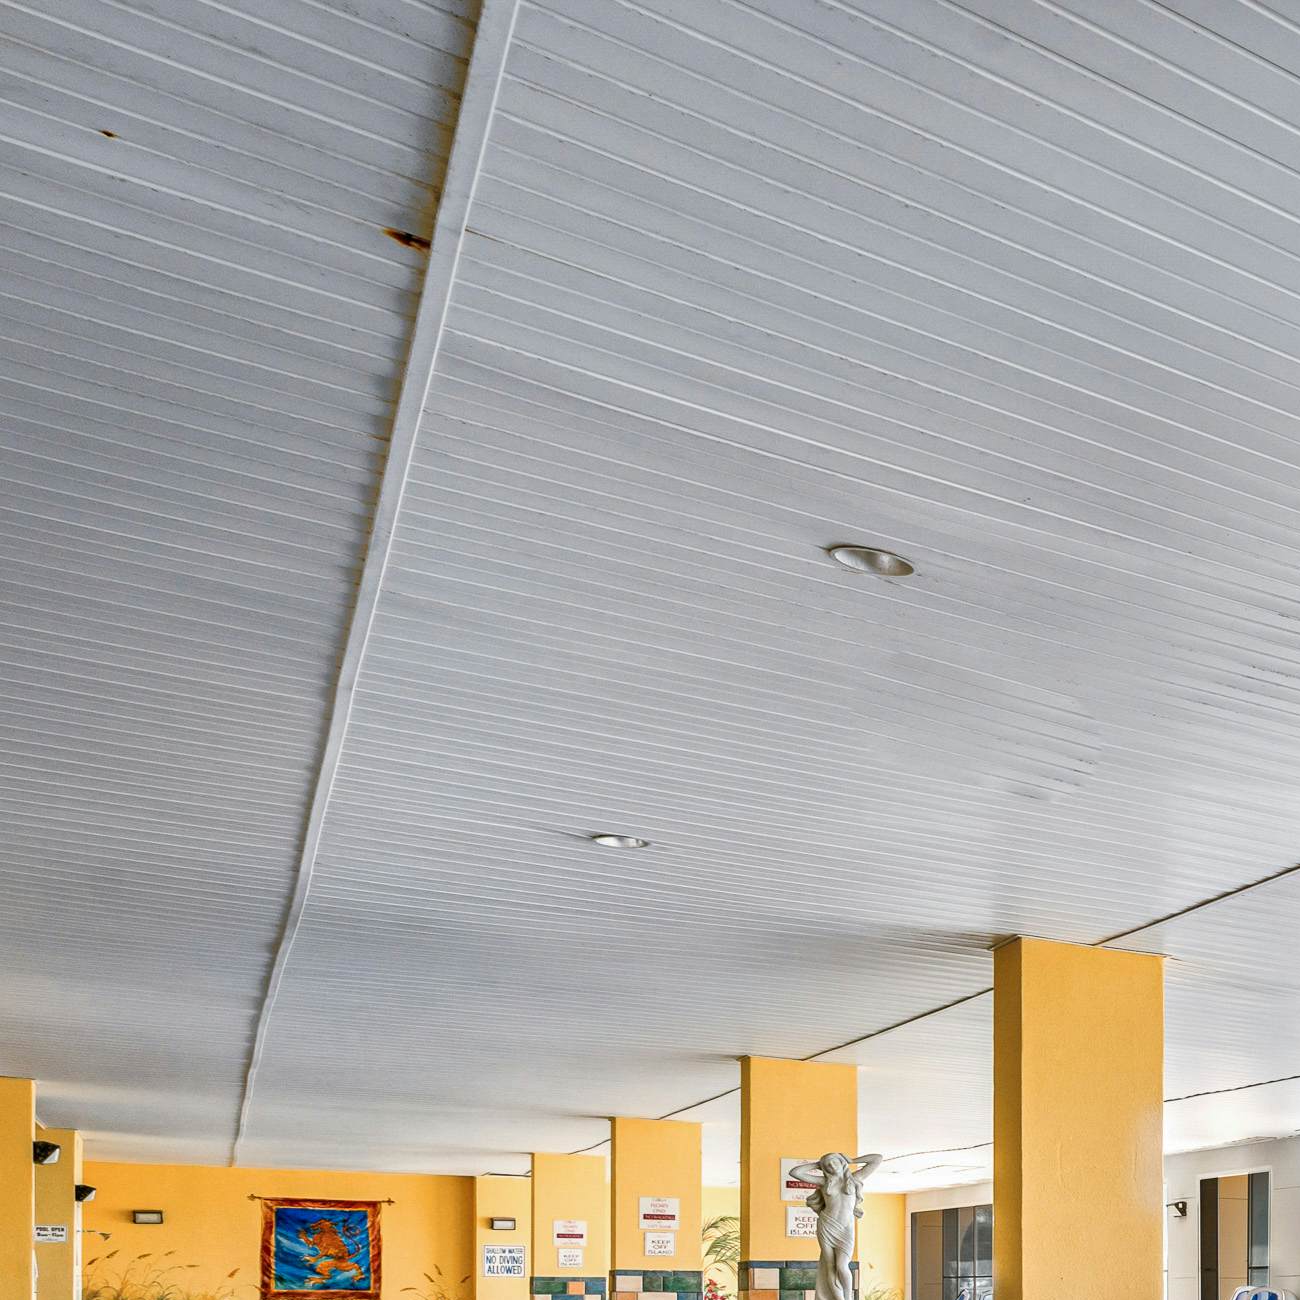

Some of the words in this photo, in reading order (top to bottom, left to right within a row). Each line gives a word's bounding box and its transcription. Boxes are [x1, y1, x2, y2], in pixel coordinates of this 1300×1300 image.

[486, 1256, 496, 1264] NO
[500, 1256, 523, 1264] DIVING
[487, 1266, 522, 1274] ALLOWED
